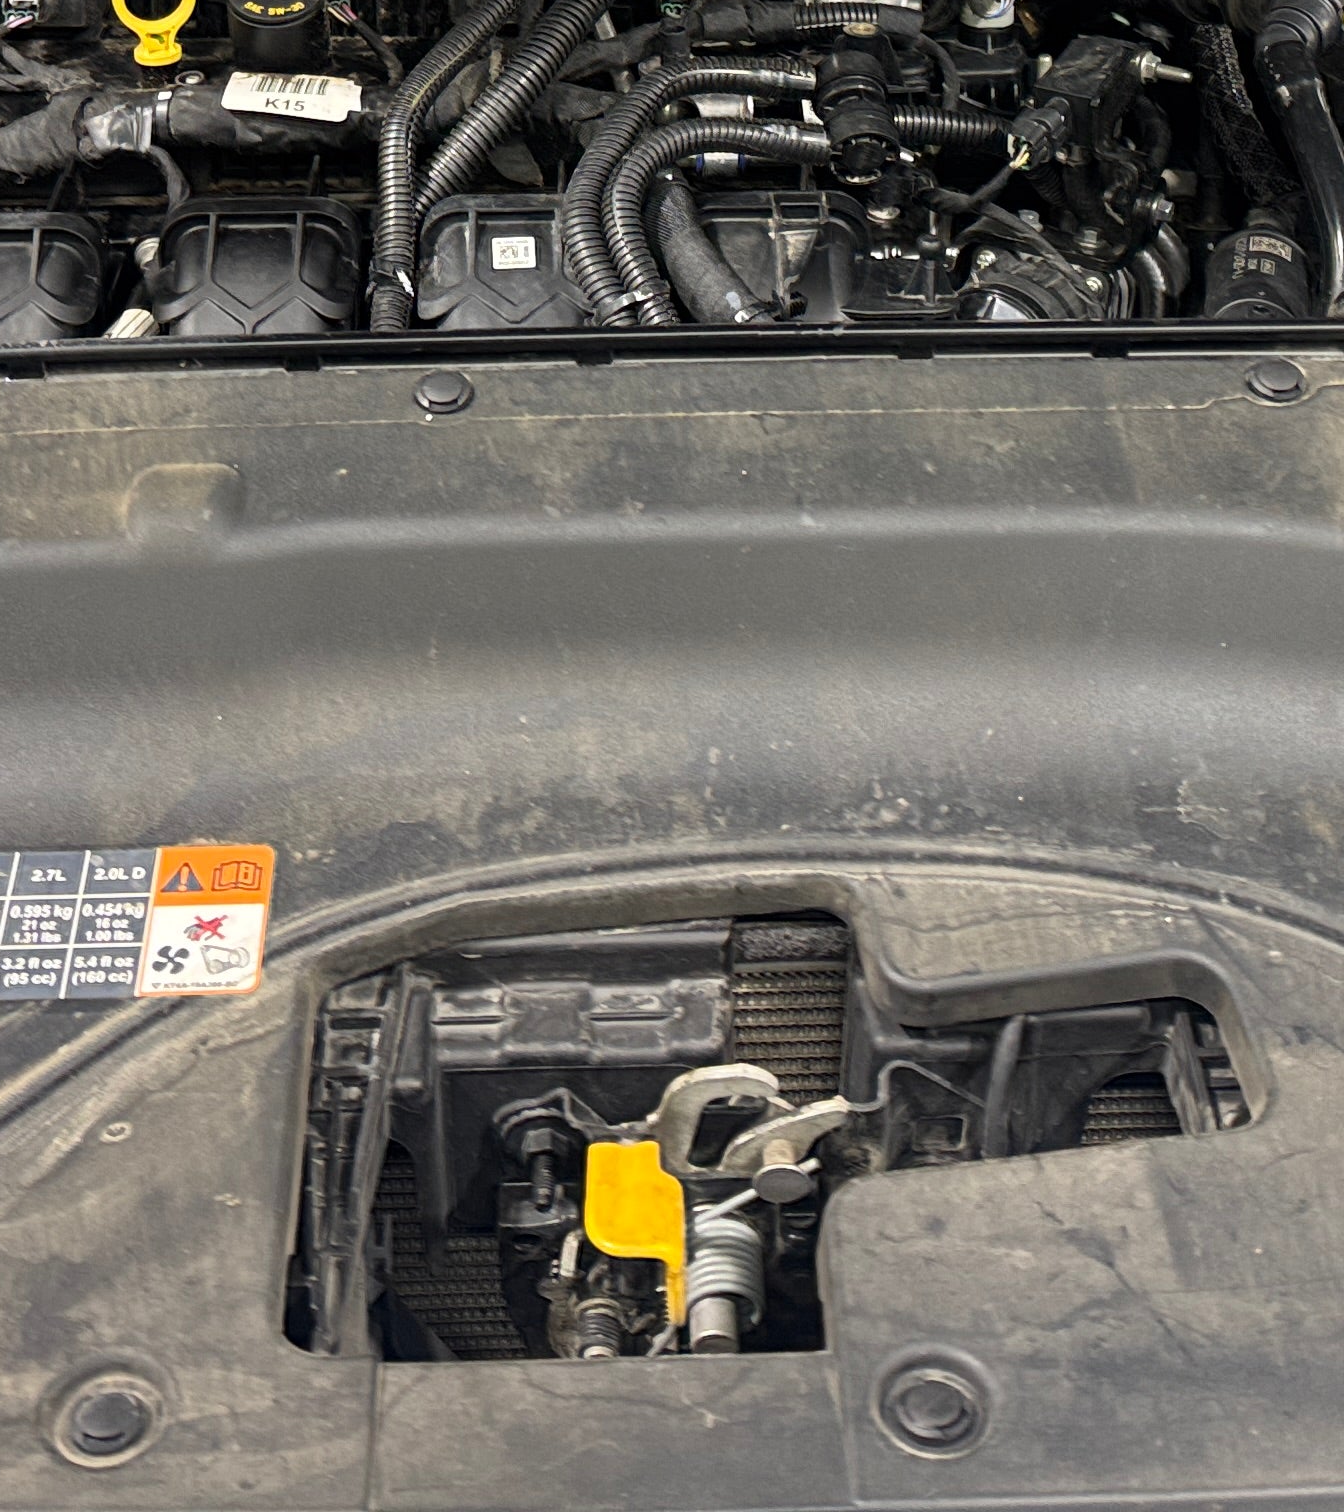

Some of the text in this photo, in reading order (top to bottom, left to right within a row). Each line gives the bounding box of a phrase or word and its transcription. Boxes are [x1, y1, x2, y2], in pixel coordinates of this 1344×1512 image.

[264, 98, 306, 112] K15
[31, 869, 67, 882] 2.7L
[93, 866, 146, 881] 2.0L D
[9, 904, 73, 921] 0.595 kg
[21, 919, 57, 931] 21 oz
[112, 919, 129, 929] oz
[1, 957, 63, 970] 3.2 fl oz
[73, 956, 135, 968] 5.4 fl oz
[3, 971, 56, 988] (95 cc)
[71, 970, 133, 986] (160 cc)
